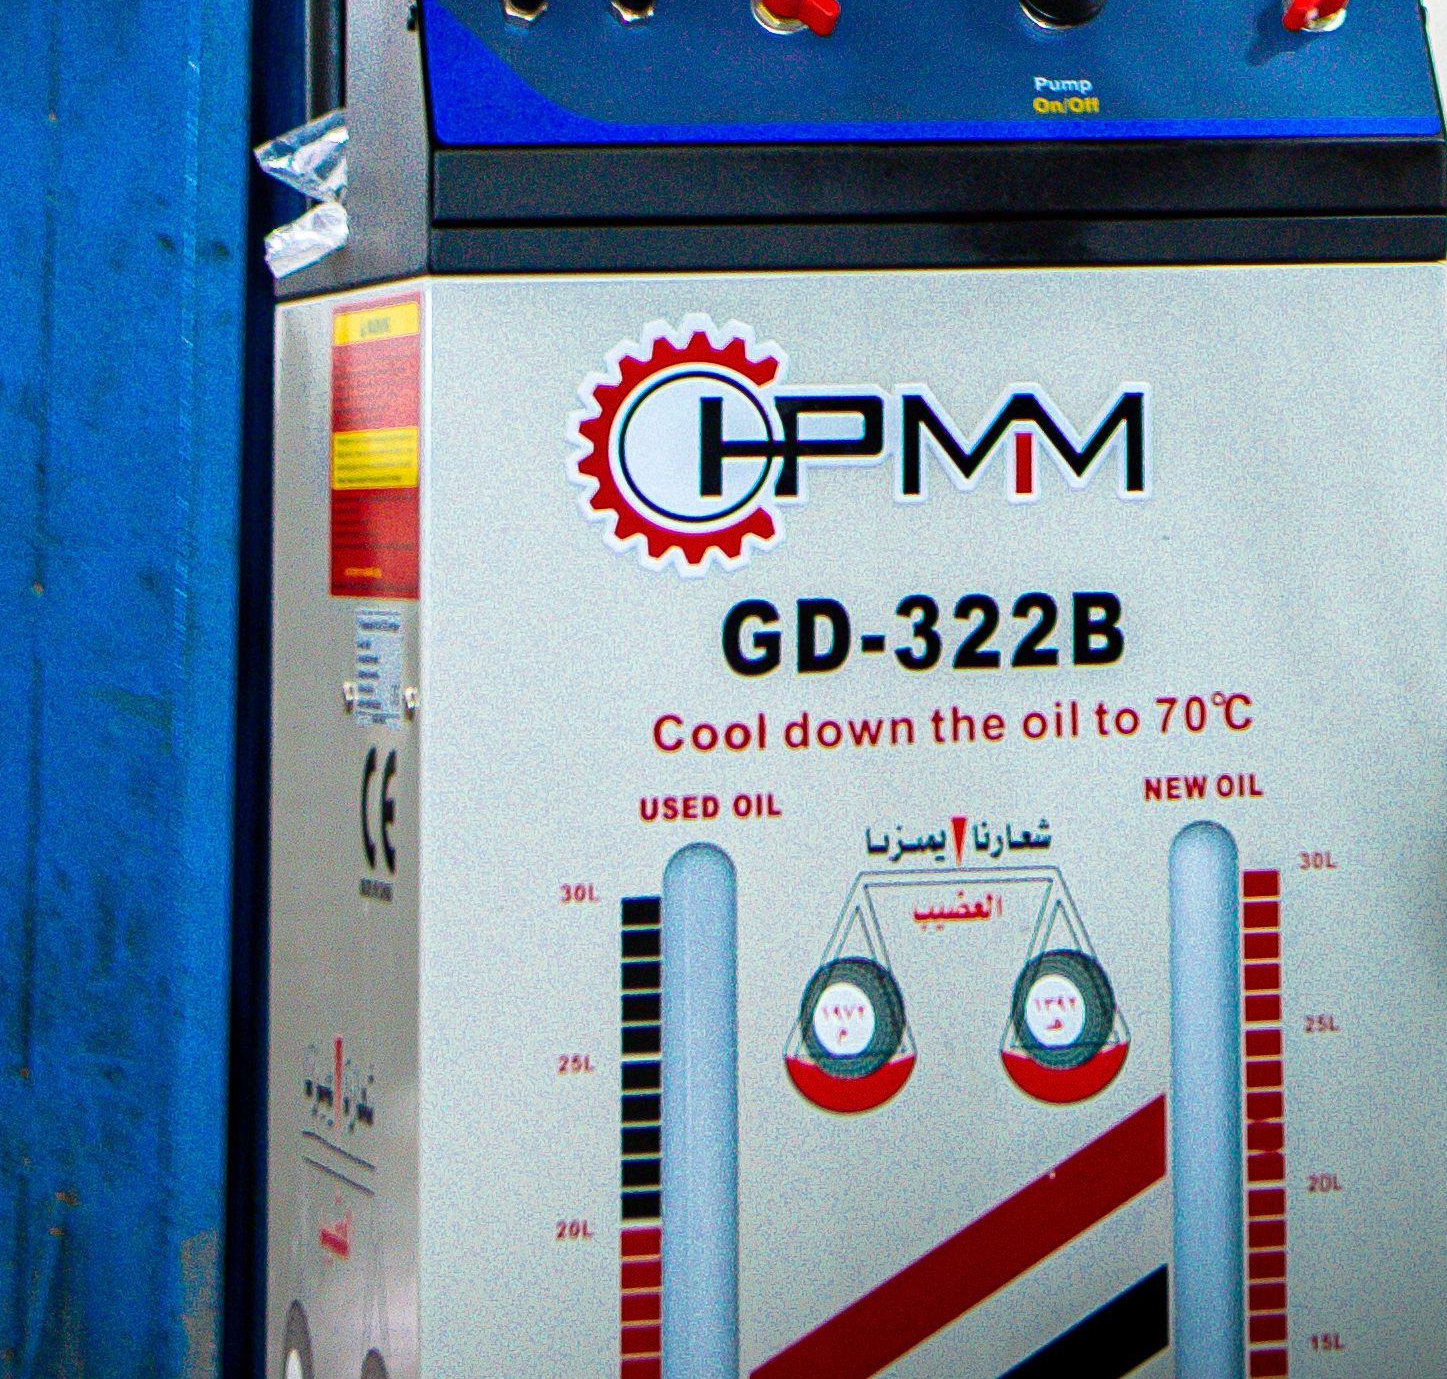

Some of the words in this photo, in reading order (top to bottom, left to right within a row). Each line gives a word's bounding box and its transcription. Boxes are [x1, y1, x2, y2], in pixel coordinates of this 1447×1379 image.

[1033, 75, 1093, 93] Pump
[1032, 96, 1100, 114] On/Off
[722, 591, 1124, 677] GD-322B
[652, 713, 767, 753] Cool
[783, 712, 915, 750] down
[930, 706, 1005, 745] the
[1022, 701, 1079, 741] oil
[1095, 703, 1140, 737] to
[1144, 777, 1207, 801] NEW
[1216, 774, 1263, 798] OIL
[640, 795, 719, 821] USED
[732, 794, 782, 817] OIL
[1300, 851, 1337, 871] 30L
[562, 884, 598, 904] 30L
[1304, 1014, 1340, 1035] 25L
[557, 1054, 594, 1074] 25L
[1307, 1174, 1342, 1194] 20L
[555, 1220, 594, 1241] 20L
[1310, 1333, 1344, 1352] 15L
